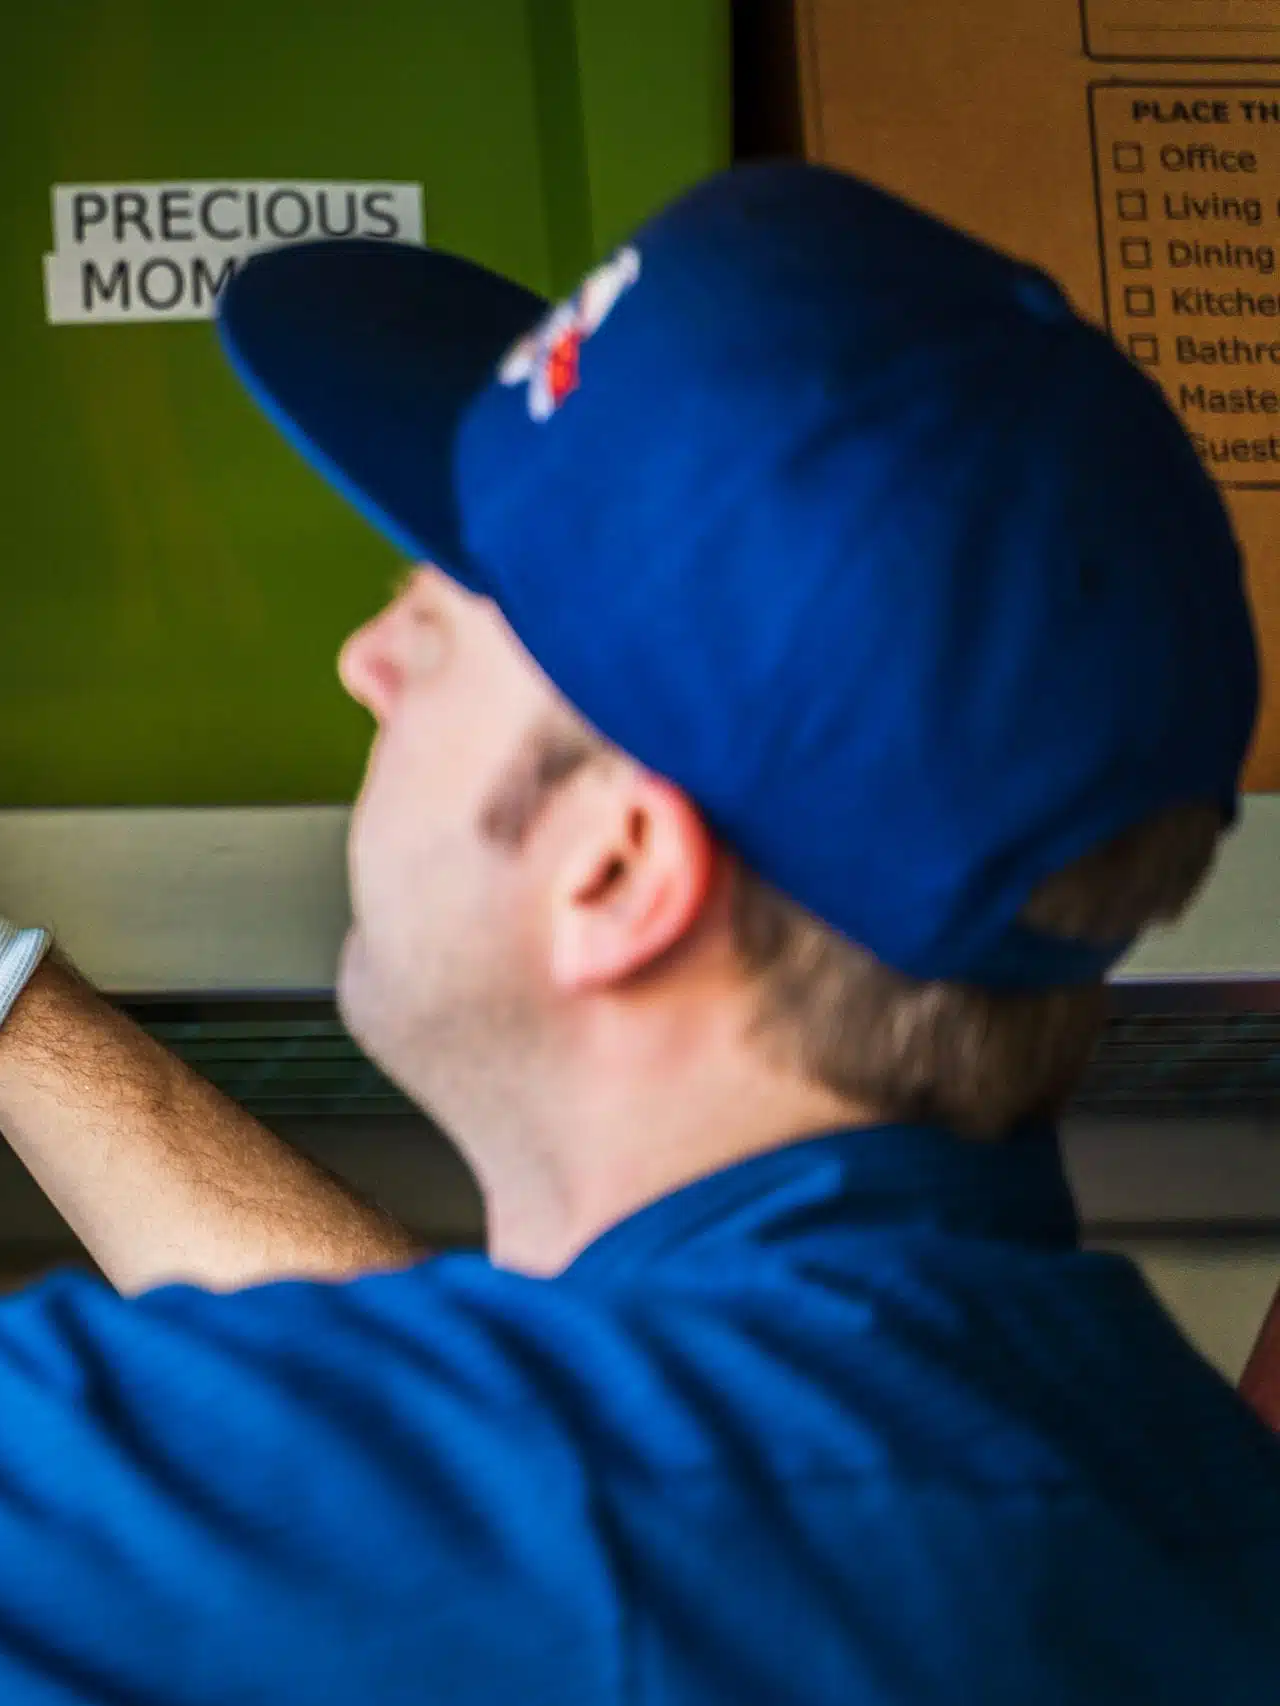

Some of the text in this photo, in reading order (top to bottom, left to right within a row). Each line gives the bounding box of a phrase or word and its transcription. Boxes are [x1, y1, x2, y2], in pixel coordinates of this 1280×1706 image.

[1132, 101, 1231, 124] PLACE
[1160, 143, 1258, 173] Office
[72, 189, 400, 243] PRECIOUS
[1163, 191, 1262, 226] Living
[1167, 239, 1276, 274] Dining
[1172, 286, 1280, 317] Kitche
